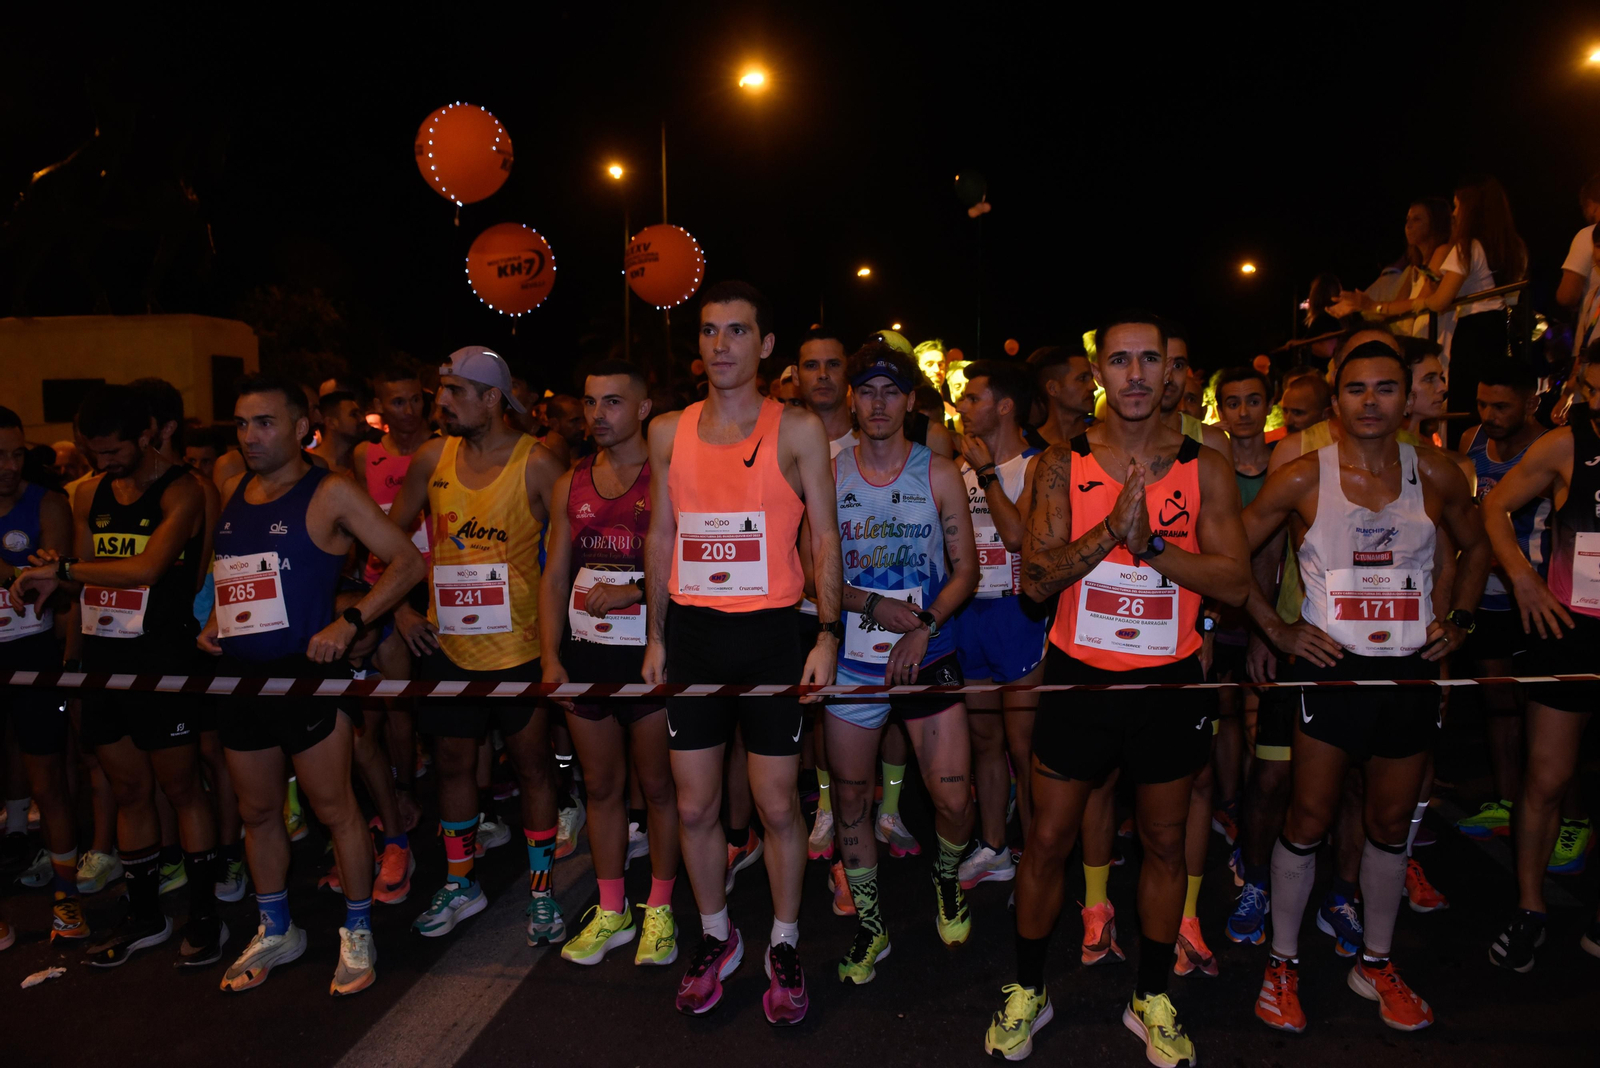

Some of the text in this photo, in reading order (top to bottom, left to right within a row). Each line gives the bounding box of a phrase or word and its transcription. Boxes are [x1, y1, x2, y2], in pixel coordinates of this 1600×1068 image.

[457, 516, 508, 542] Álora
[840, 516, 932, 542] Atletismo
[1154, 529, 1188, 539] ABRAHAM
[97, 537, 135, 555] ASM
[580, 535, 642, 552] SOBERBIO
[701, 542, 736, 560] 209
[845, 545, 927, 569] Bollullos
[979, 550, 988, 564] 5
[99, 590, 117, 606] 91
[228, 583, 256, 602] 265
[455, 589, 482, 605] 241
[1116, 596, 1145, 617] 26
[1359, 600, 1394, 618] 171
[1090, 613, 1114, 621] ABRAHAM
[843, 837, 859, 846] 999
